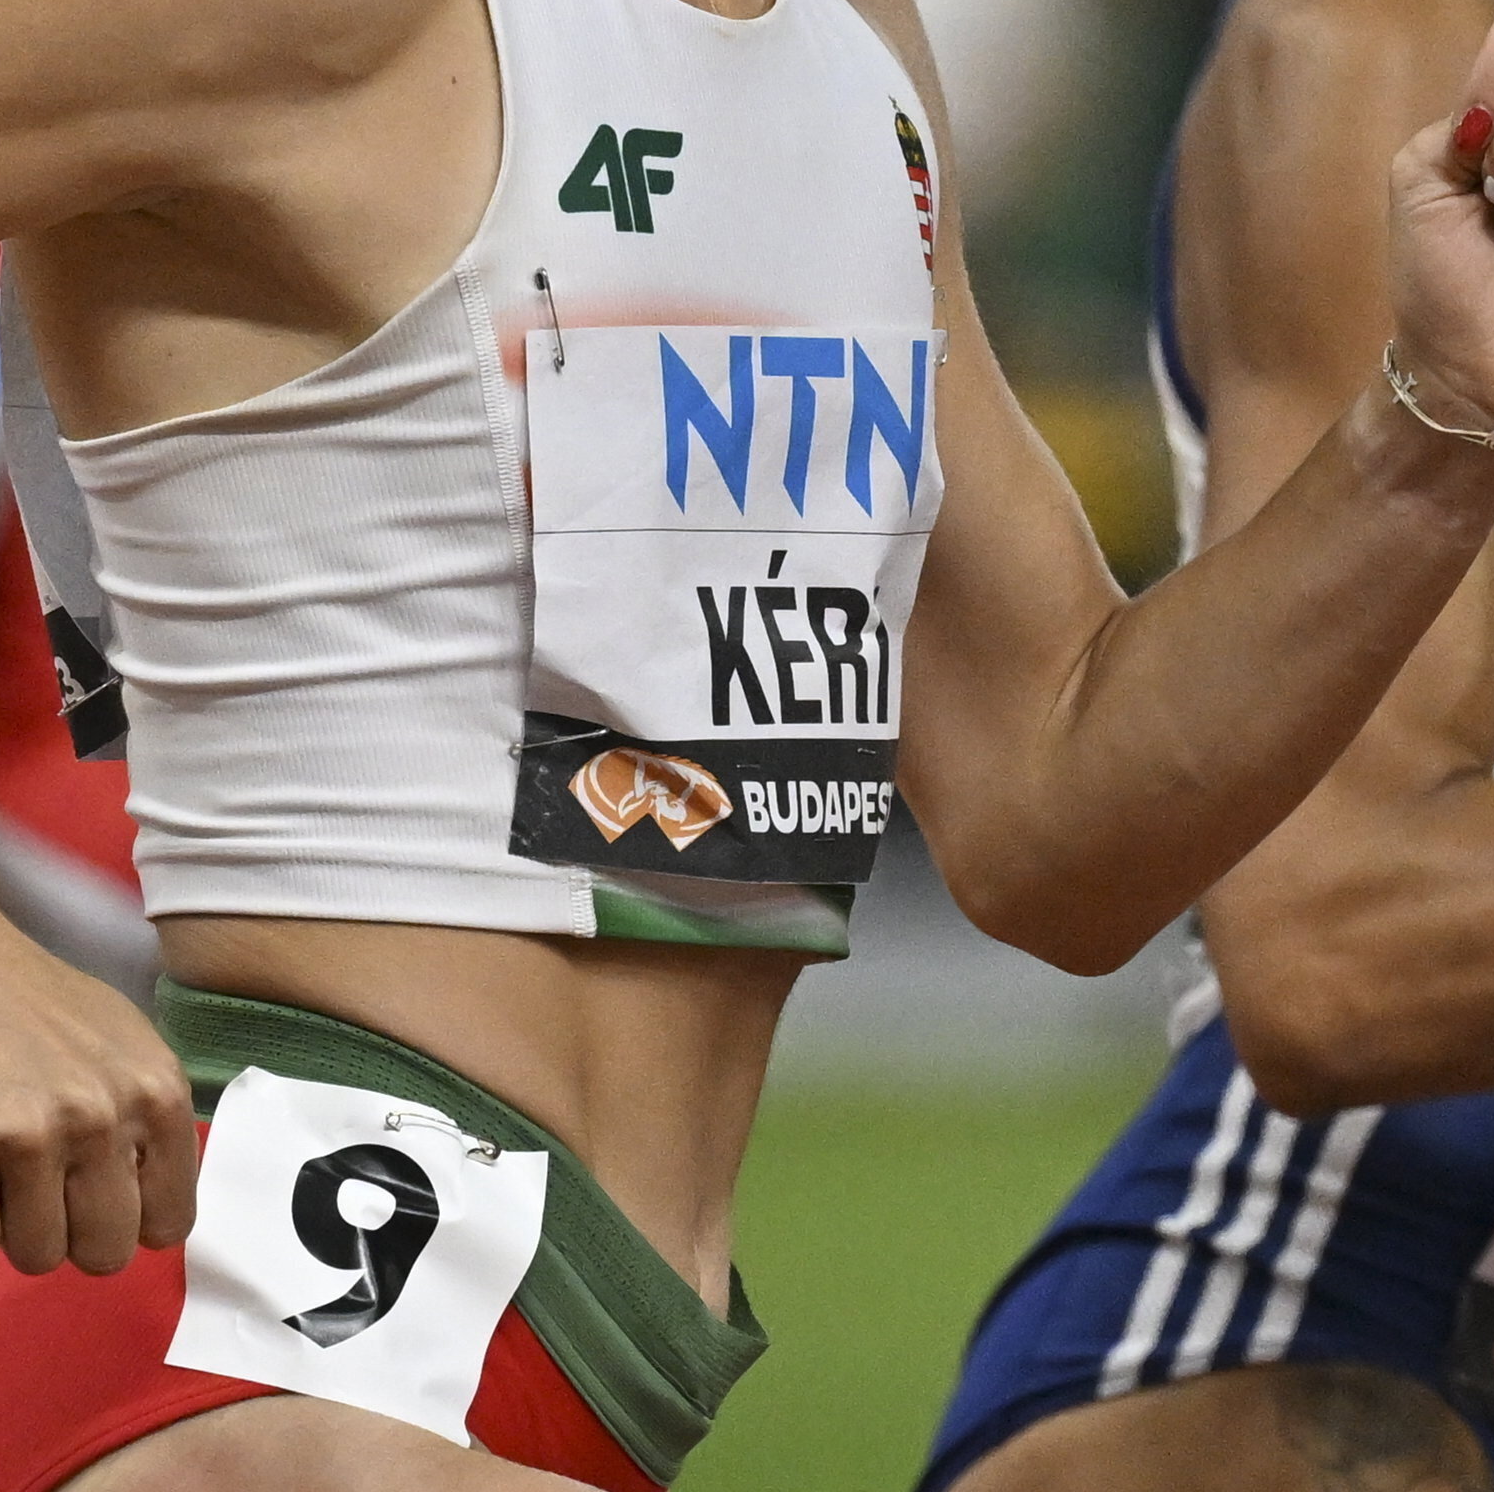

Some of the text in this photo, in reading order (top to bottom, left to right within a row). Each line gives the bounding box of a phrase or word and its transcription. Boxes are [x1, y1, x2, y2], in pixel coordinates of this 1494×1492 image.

[558, 124, 682, 234] 4F
[658, 331, 929, 520] NTN
[696, 549, 890, 726] KÉRI
[741, 780, 895, 835] BUDAPES
[281, 1143, 440, 1349] 9
